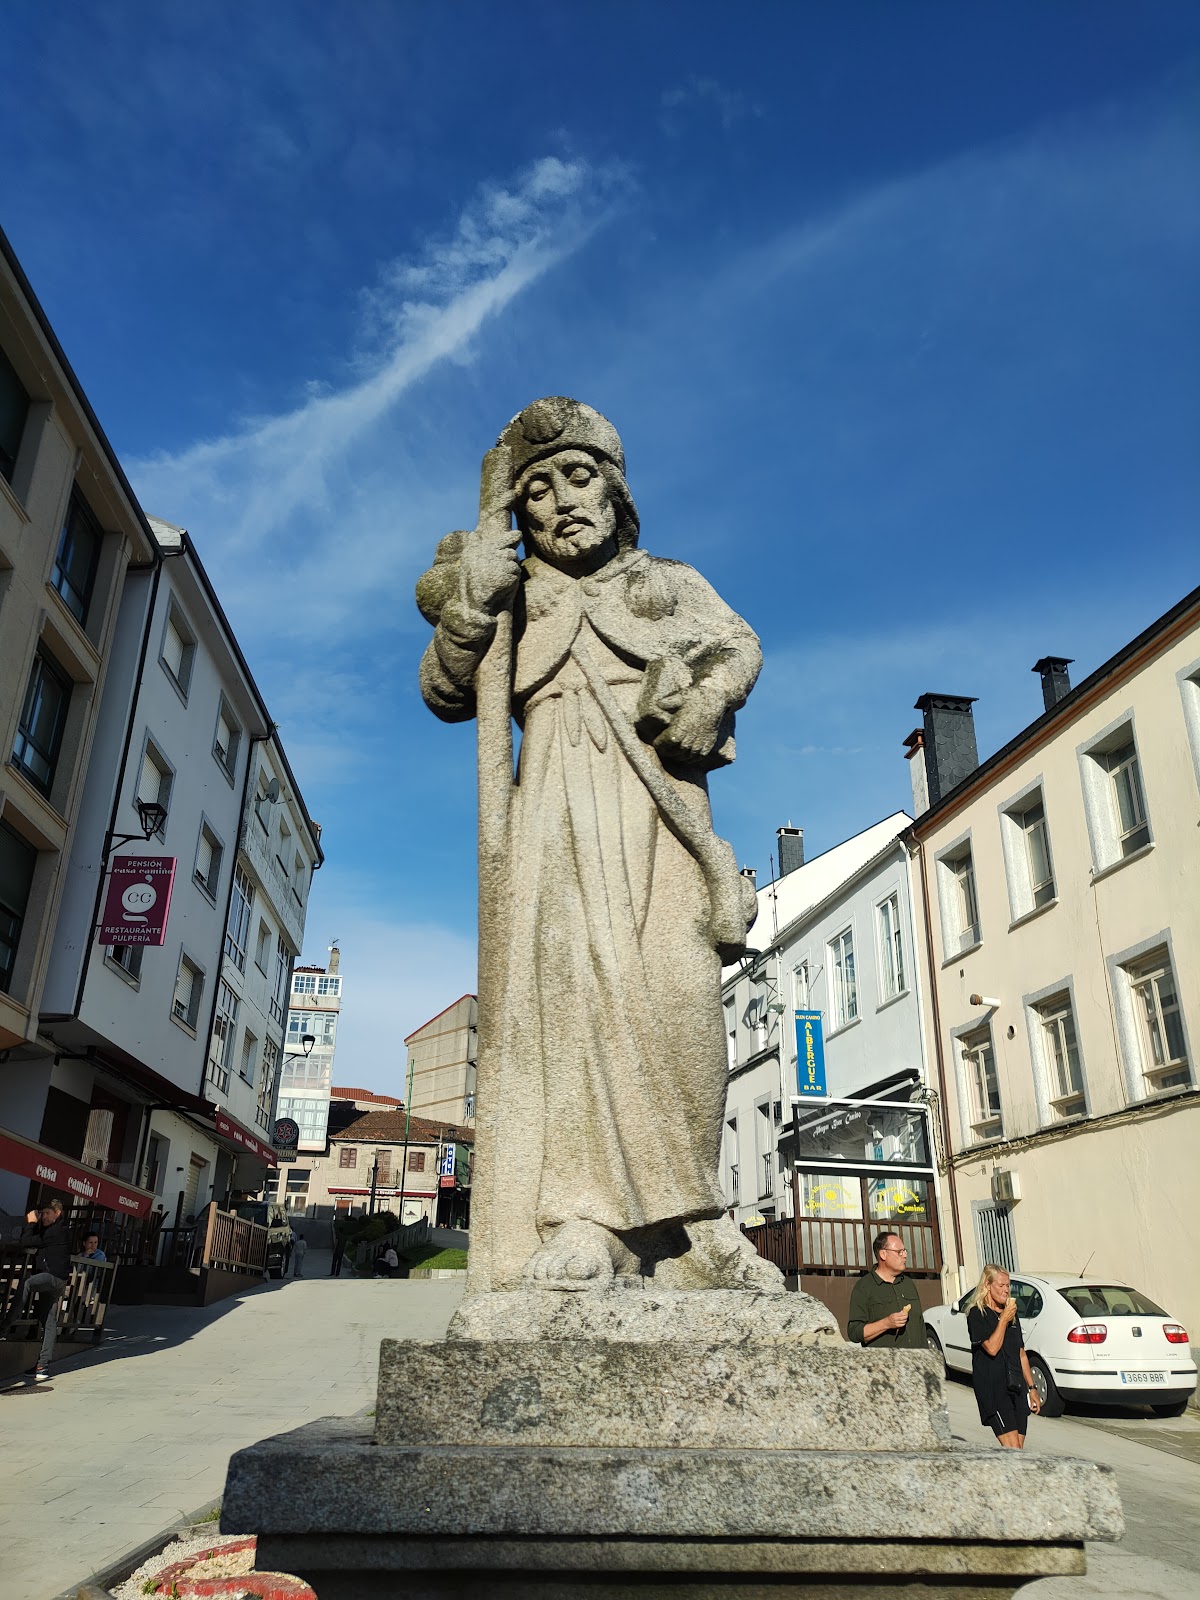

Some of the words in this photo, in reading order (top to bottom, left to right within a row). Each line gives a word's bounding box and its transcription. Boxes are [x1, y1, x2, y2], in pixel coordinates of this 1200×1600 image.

[112, 934, 151, 942] PULPERÍA
[804, 1021, 816, 1084] ALBERGUE
[36, 1164, 57, 1182] casa
[67, 1176, 94, 1198] camiño
[118, 1195, 139, 1210] RESTAURANTE
[897, 1203, 925, 1214] Camino
[1149, 1373, 1165, 1383] BBR
